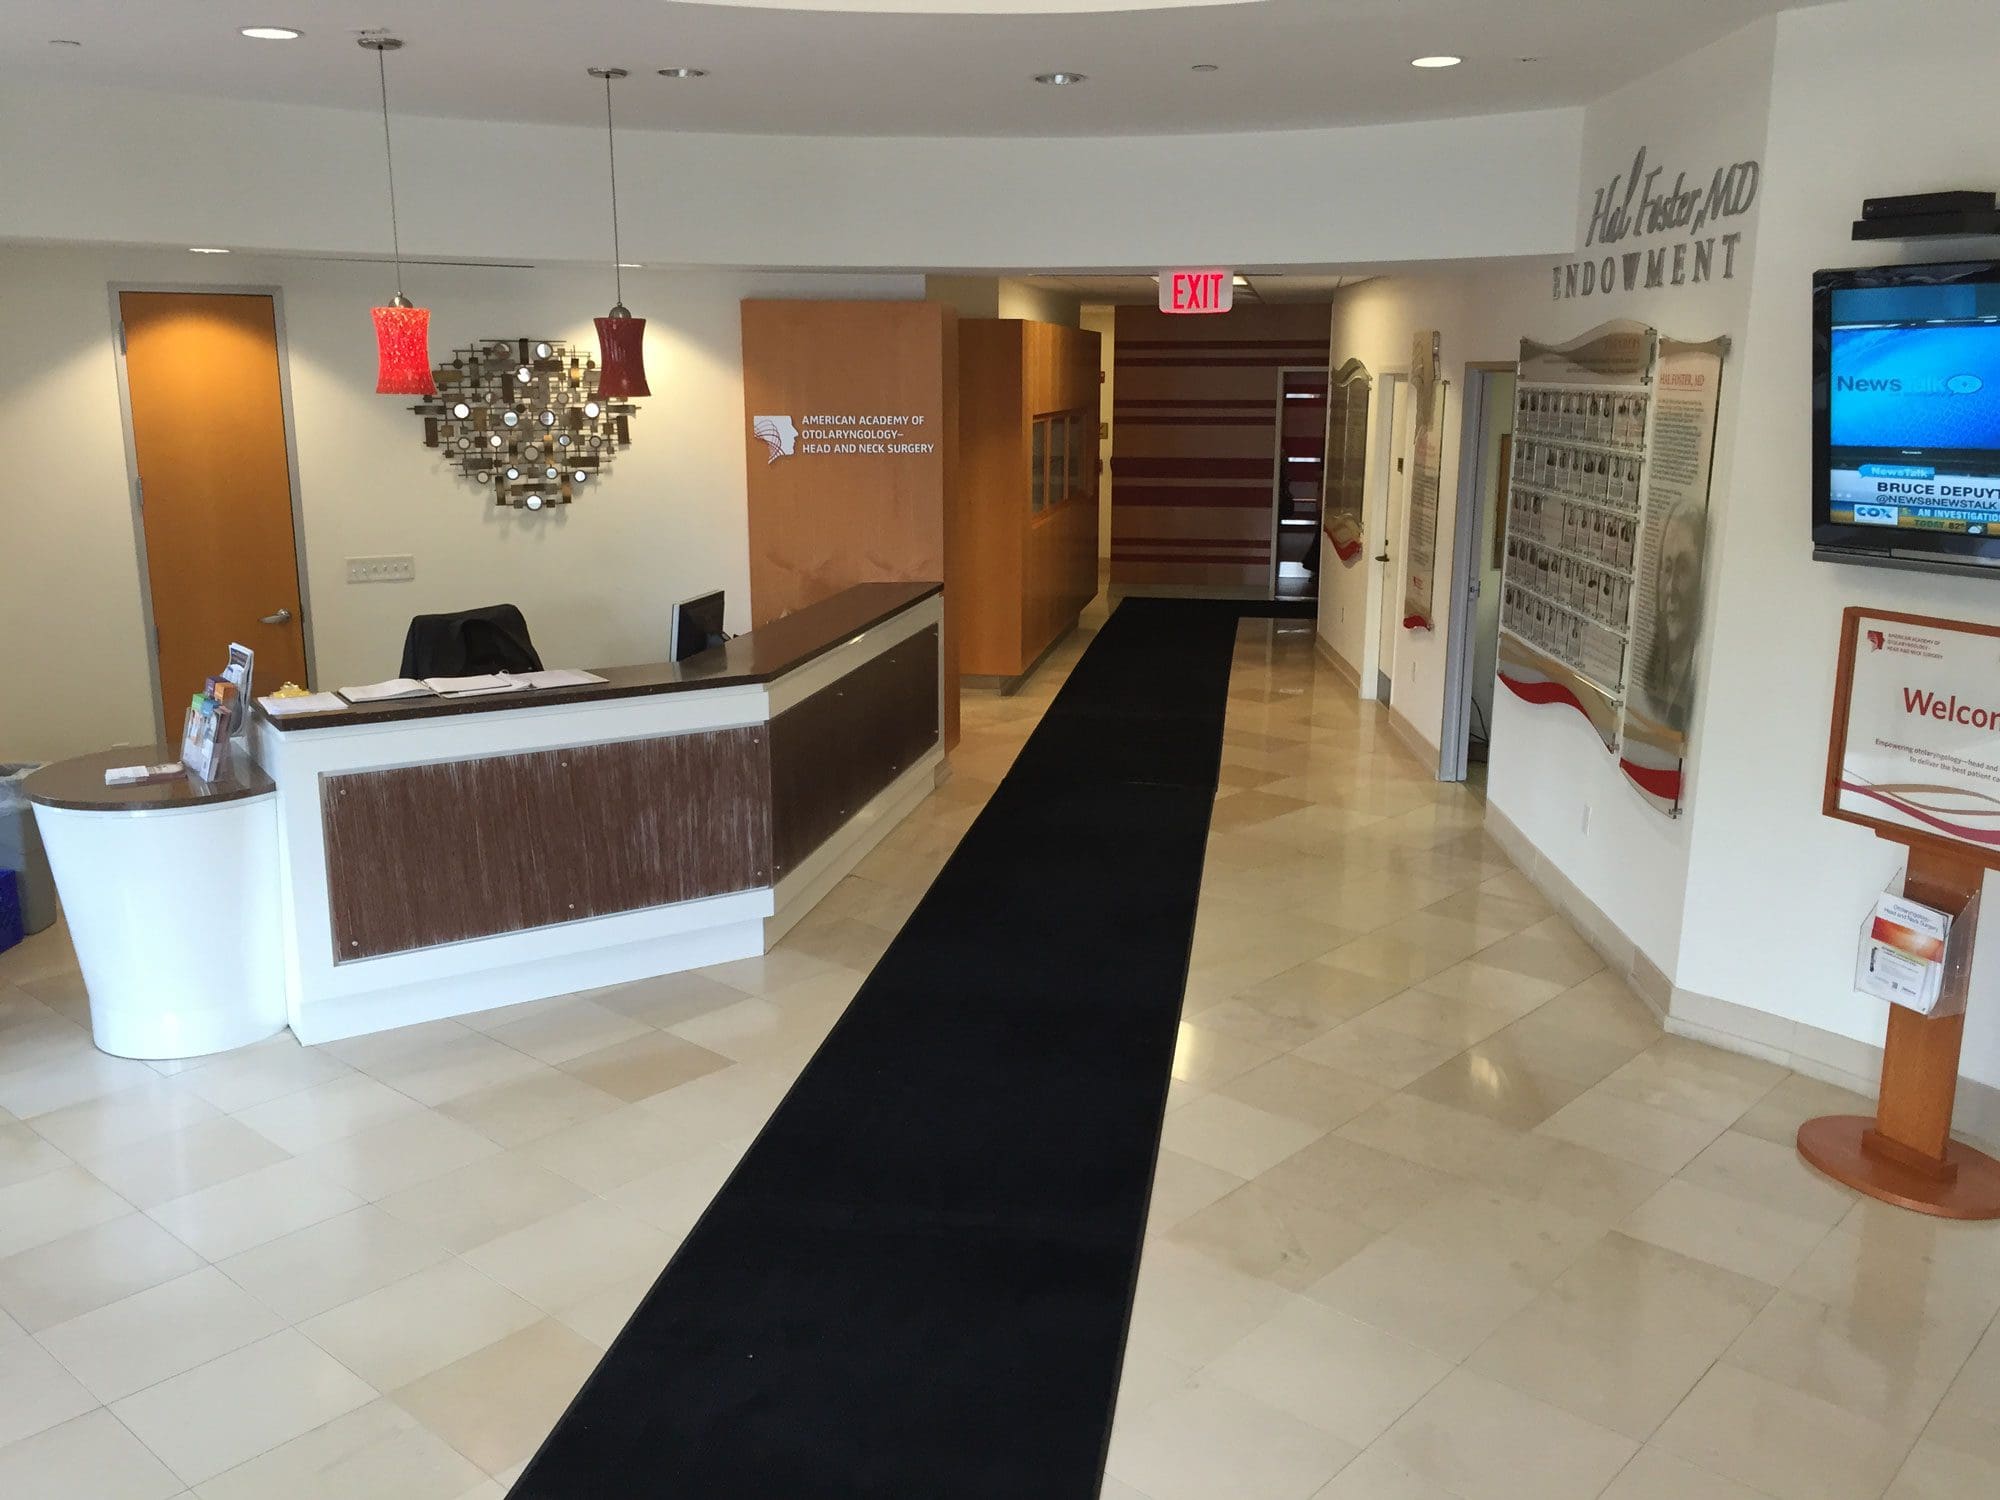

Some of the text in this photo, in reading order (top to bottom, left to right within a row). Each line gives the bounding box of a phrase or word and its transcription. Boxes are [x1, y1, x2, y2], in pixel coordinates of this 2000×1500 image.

[1585, 146, 1647, 247] Hal
[1552, 231, 1742, 301] ENDOWMENT
[1172, 274, 1224, 310] EXIT
[802, 415, 925, 425] AMERICAN ACADEMY OF
[802, 444, 935, 454] HEAD AND NECK SURGERY
[1872, 467, 1928, 478] NewsTalk
[1877, 482, 1935, 495] BRUCE
[1876, 494, 1997, 510] @NEWS8NEWSTALK
[1856, 507, 1892, 519] COX
[1917, 508, 1932, 518] AN
[1875, 738, 1914, 754] Empowering
[1985, 764, 1998, 772] and
[1918, 757, 1940, 768] deliver
[1940, 762, 1951, 771] the
[1952, 766, 1966, 775] best
[1967, 770, 1992, 781] patient
